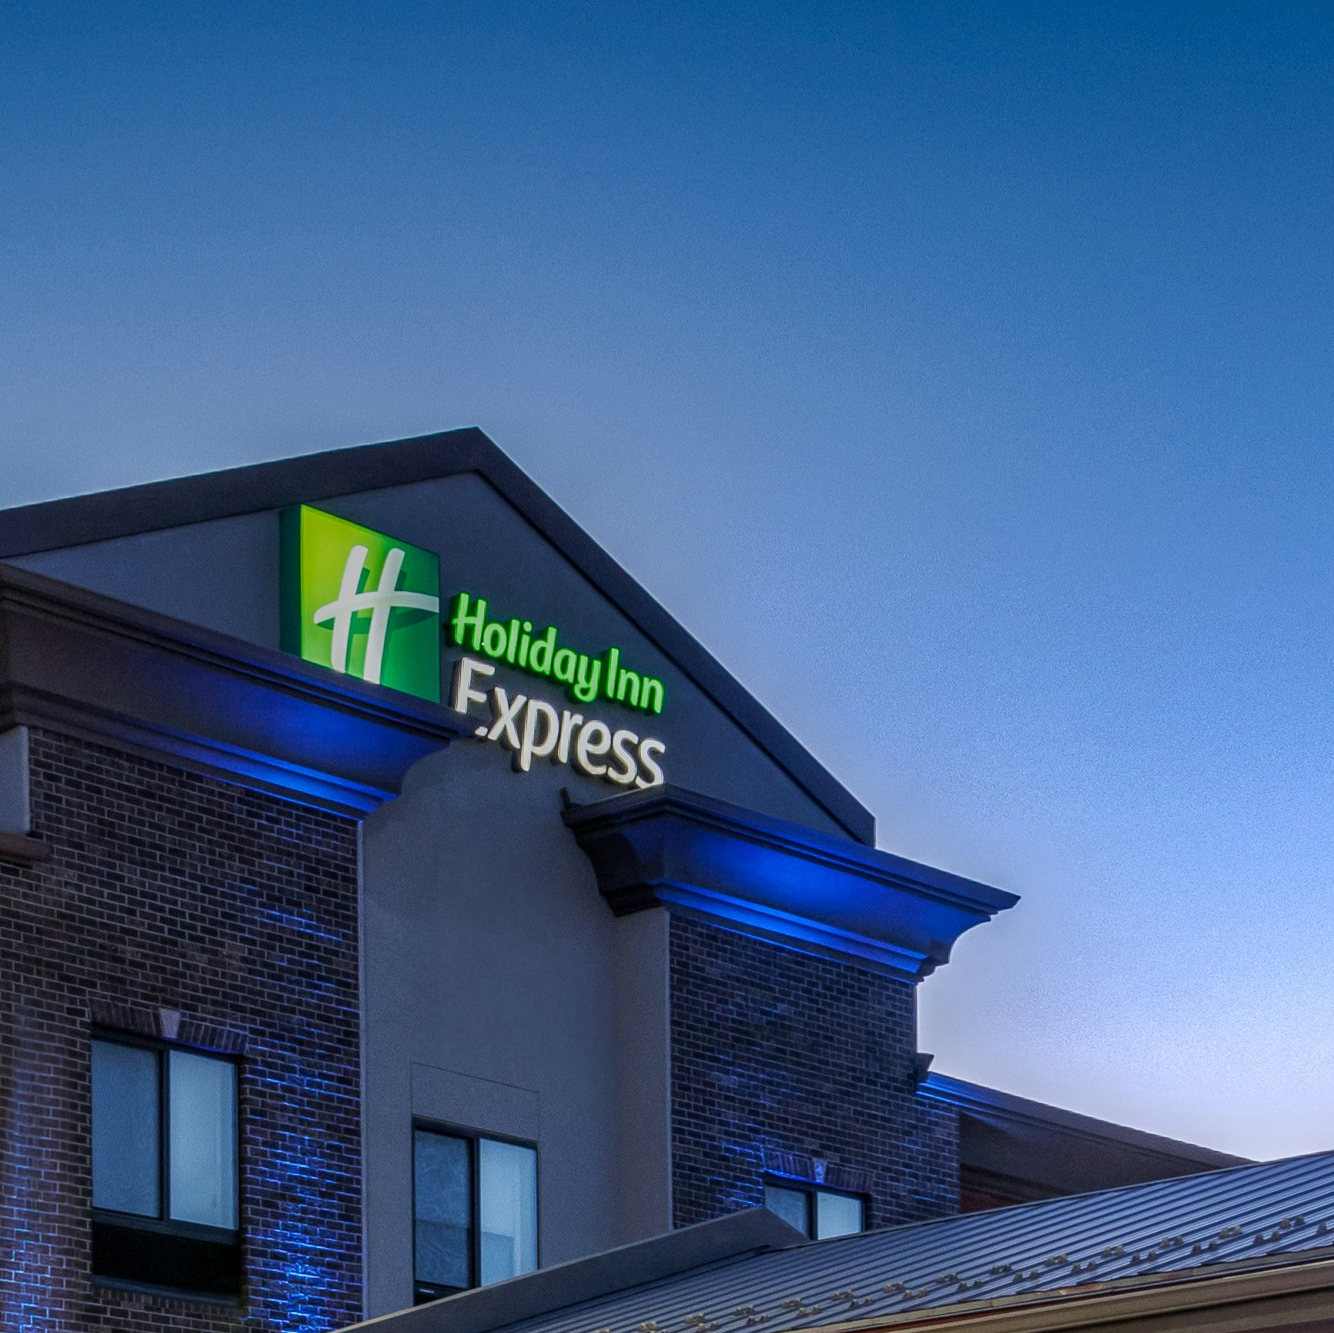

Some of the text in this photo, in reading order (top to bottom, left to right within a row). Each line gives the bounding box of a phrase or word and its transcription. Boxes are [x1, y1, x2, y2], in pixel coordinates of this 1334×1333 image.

[452, 592, 665, 714] Holiday Inn
[454, 656, 666, 789] Express
